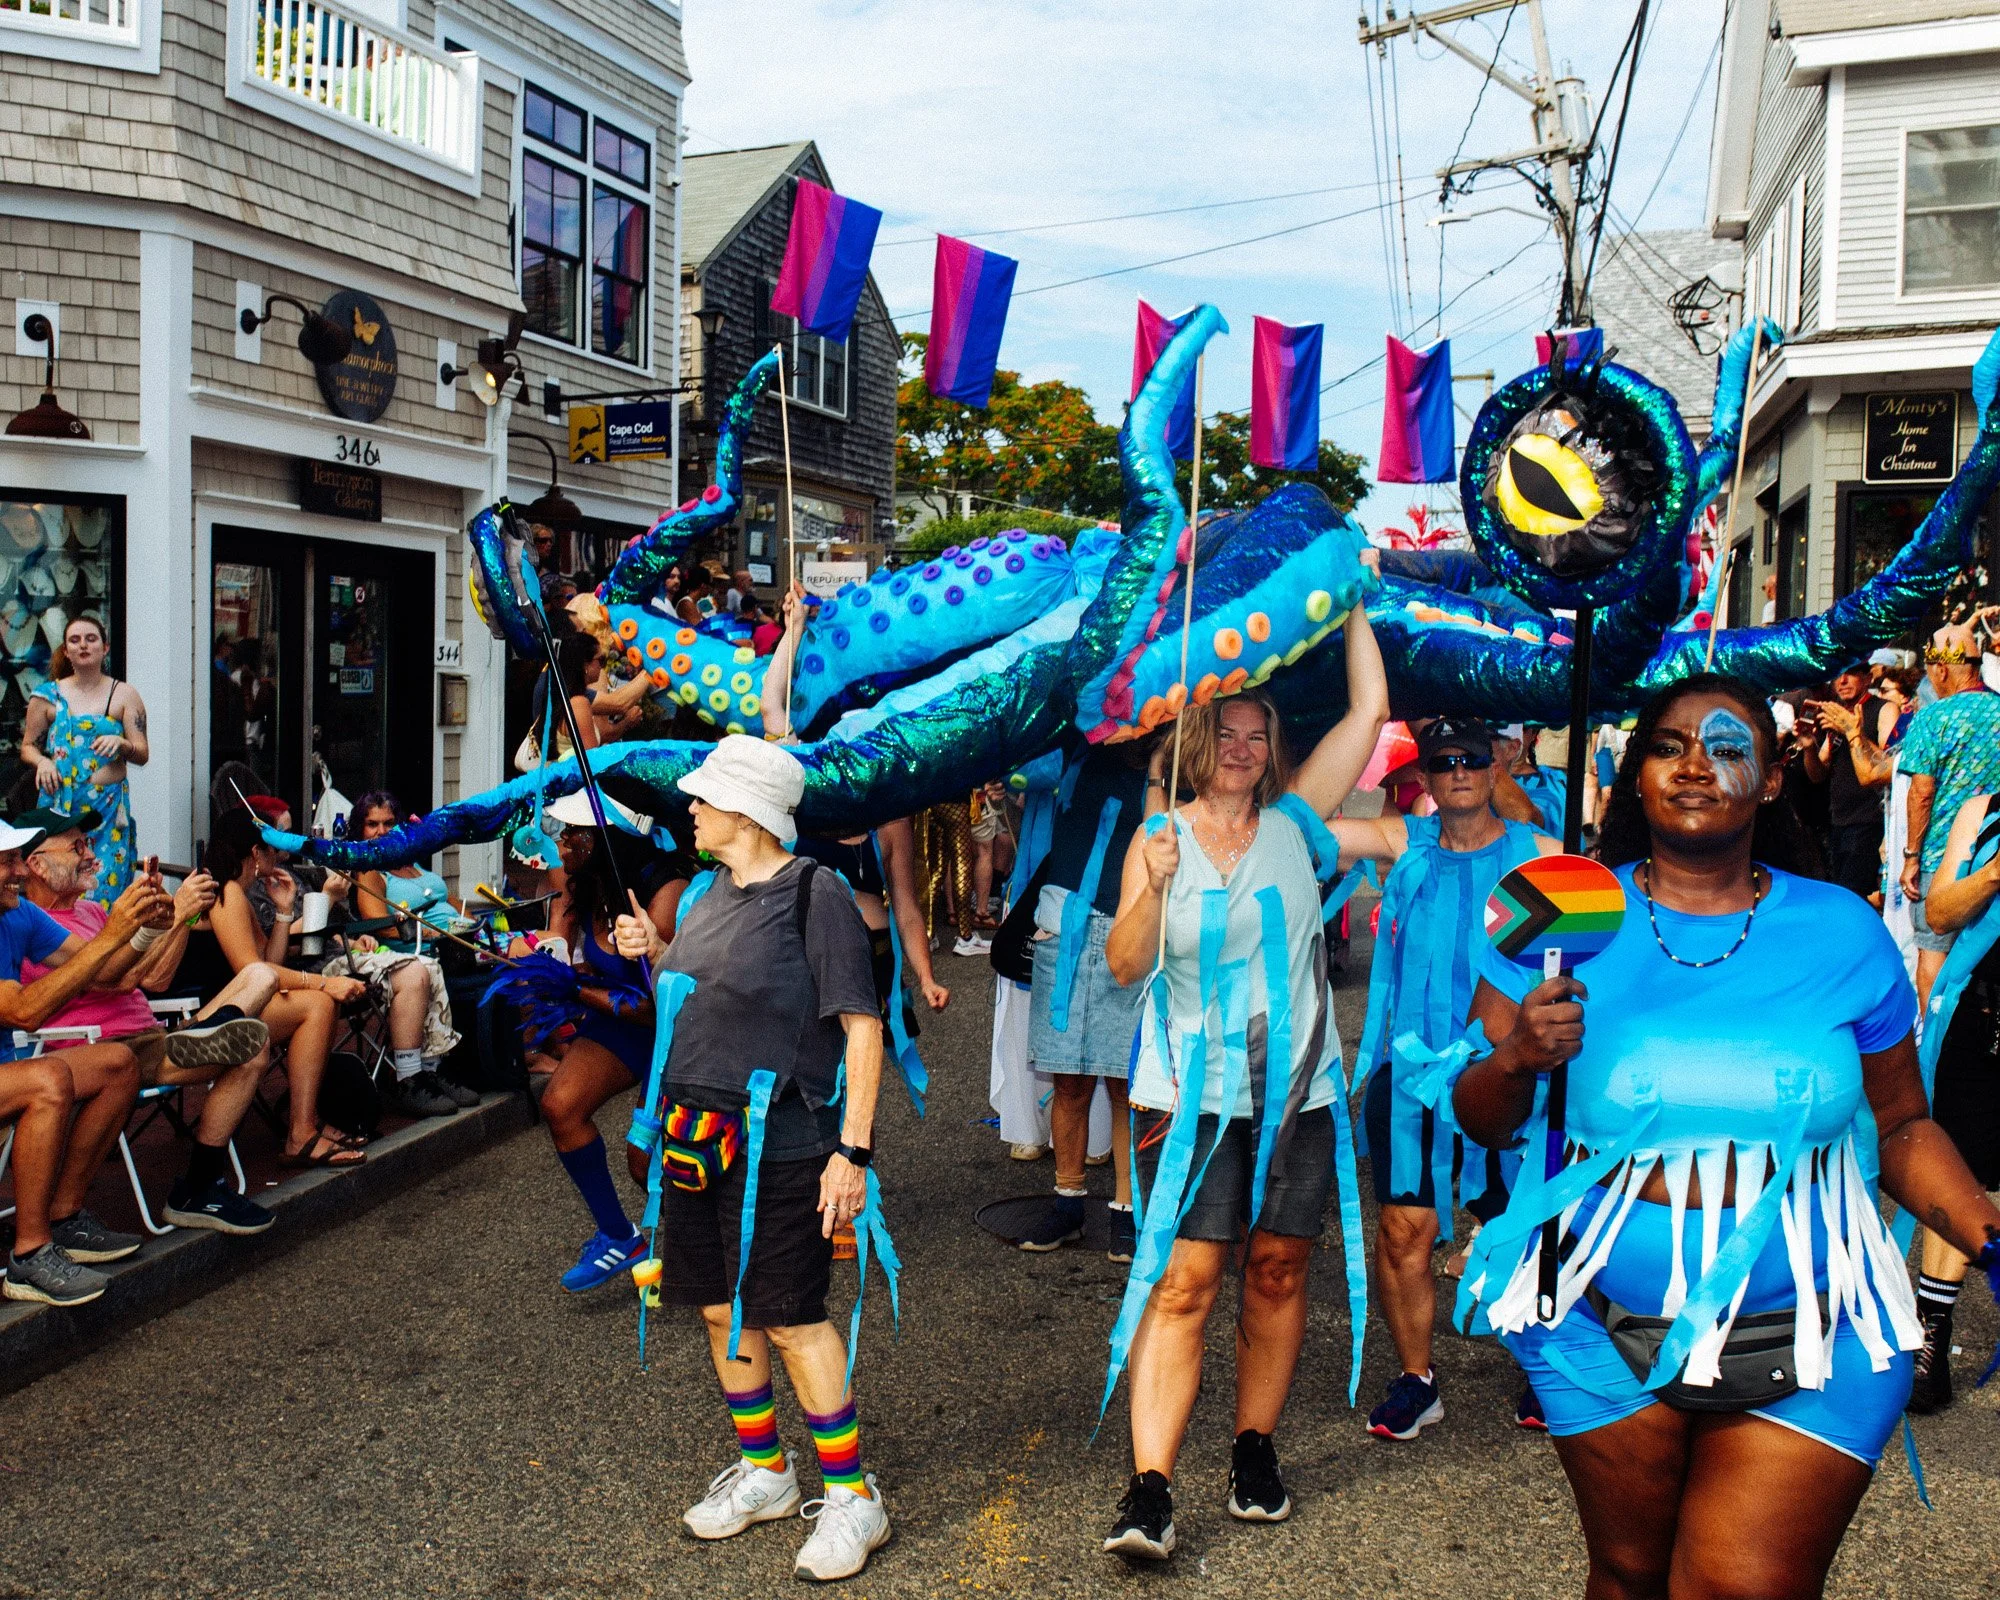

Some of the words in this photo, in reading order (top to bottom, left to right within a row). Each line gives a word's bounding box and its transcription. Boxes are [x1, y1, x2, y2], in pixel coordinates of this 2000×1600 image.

[1875, 397, 1949, 417] Monty's
[609, 424, 632, 437] Cape
[634, 422, 653, 434] Cod
[1890, 421, 1929, 437] Home
[623, 436, 640, 445] Estate
[641, 435, 667, 444] Network
[1898, 437, 1918, 457] for
[1880, 455, 1937, 472] Christmas
[437, 646, 459, 662] 344
